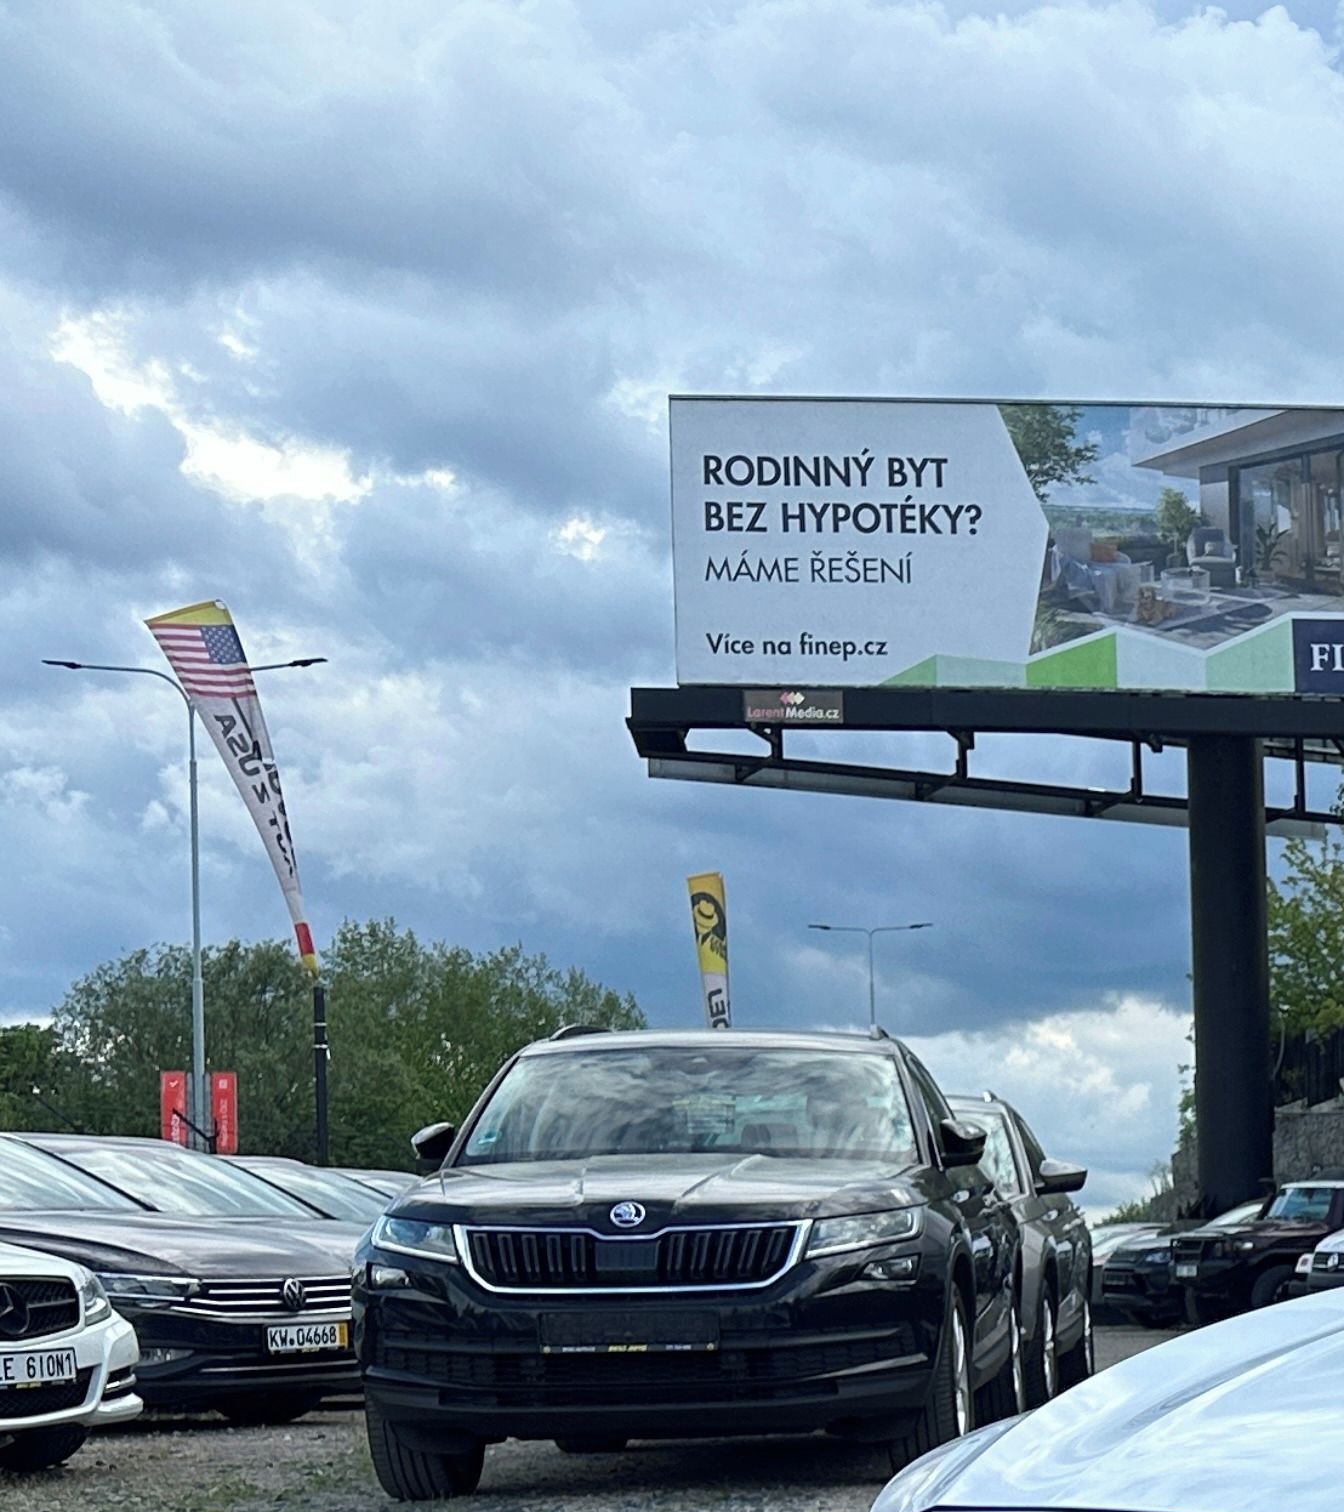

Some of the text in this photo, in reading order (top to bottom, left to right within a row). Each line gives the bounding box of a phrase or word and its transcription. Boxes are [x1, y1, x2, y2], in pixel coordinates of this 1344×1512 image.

[703, 448, 947, 489] RODINNÝ BYT
[703, 495, 983, 537] BEZ HYPOTÉKY?
[705, 548, 912, 584] MÁME ŘEŠENÍ
[706, 631, 888, 661] Více na finep.cz
